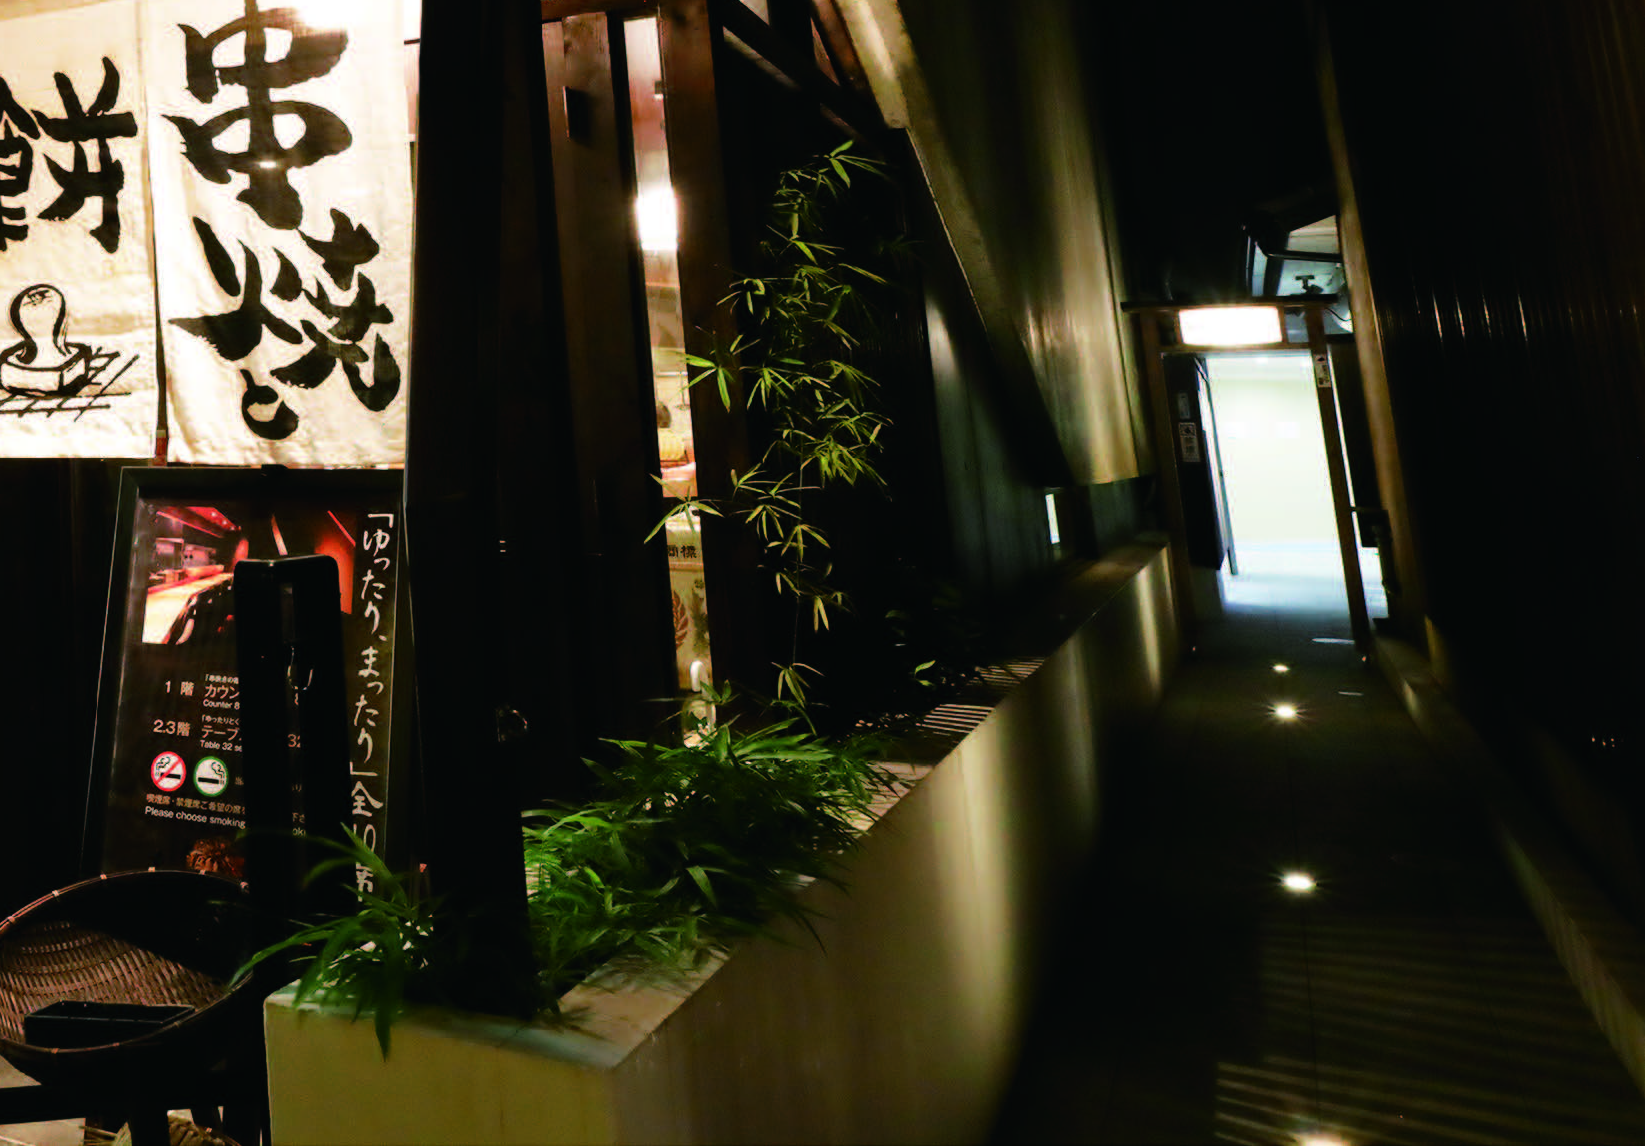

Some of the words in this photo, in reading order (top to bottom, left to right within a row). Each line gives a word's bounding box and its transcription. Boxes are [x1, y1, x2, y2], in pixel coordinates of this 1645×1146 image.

[202, 698, 233, 709] Counter
[201, 724, 242, 742] テーブ
[200, 739, 221, 750] Table
[222, 741, 233, 751] 32
[144, 805, 175, 819] Please
[176, 810, 208, 823] choose
[209, 815, 246, 830] smoking
